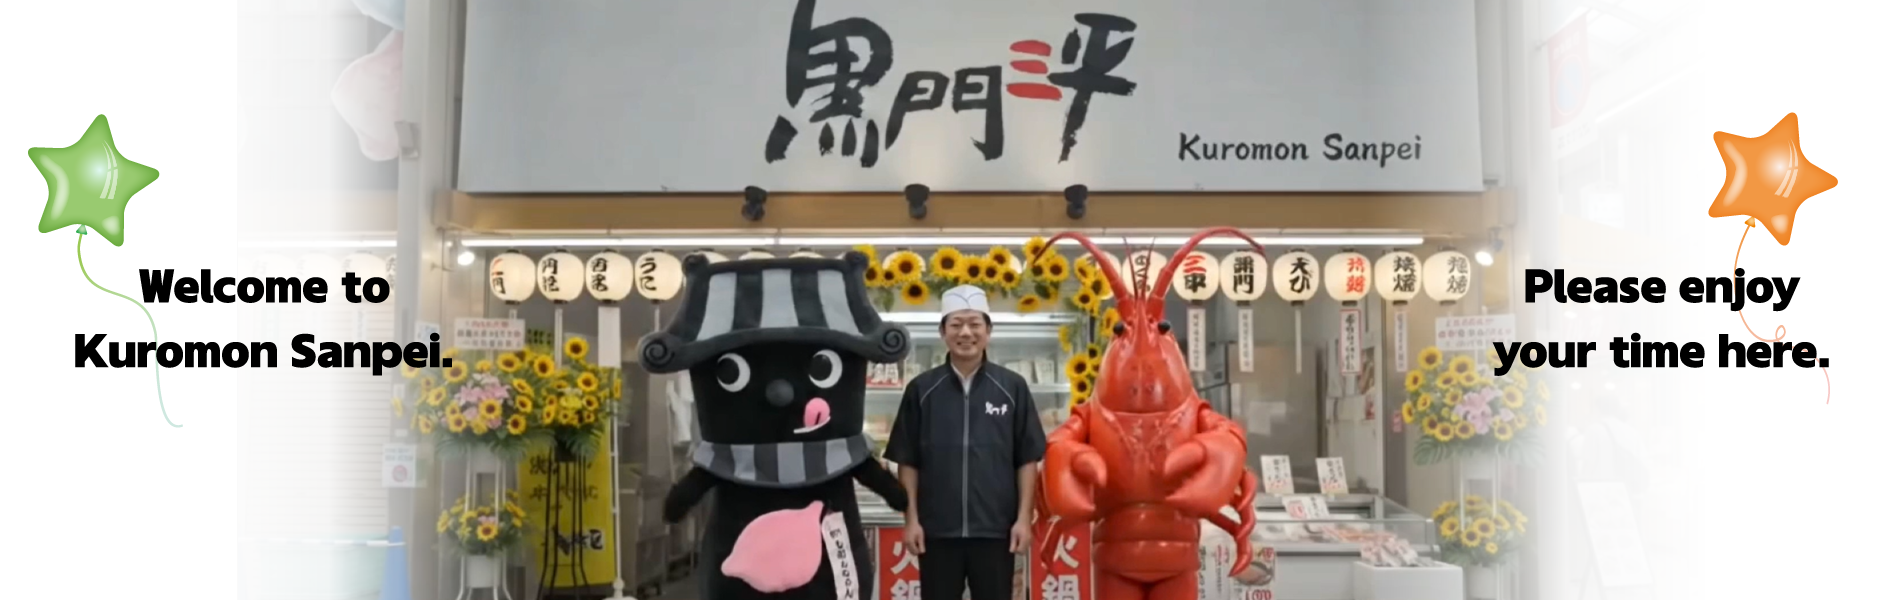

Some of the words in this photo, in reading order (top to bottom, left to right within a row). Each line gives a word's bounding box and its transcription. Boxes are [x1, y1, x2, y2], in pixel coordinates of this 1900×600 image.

[765, 0, 1136, 167] 黒門三平
[1178, 132, 1309, 161] Kuromon
[1323, 133, 1421, 168] Sanpei
